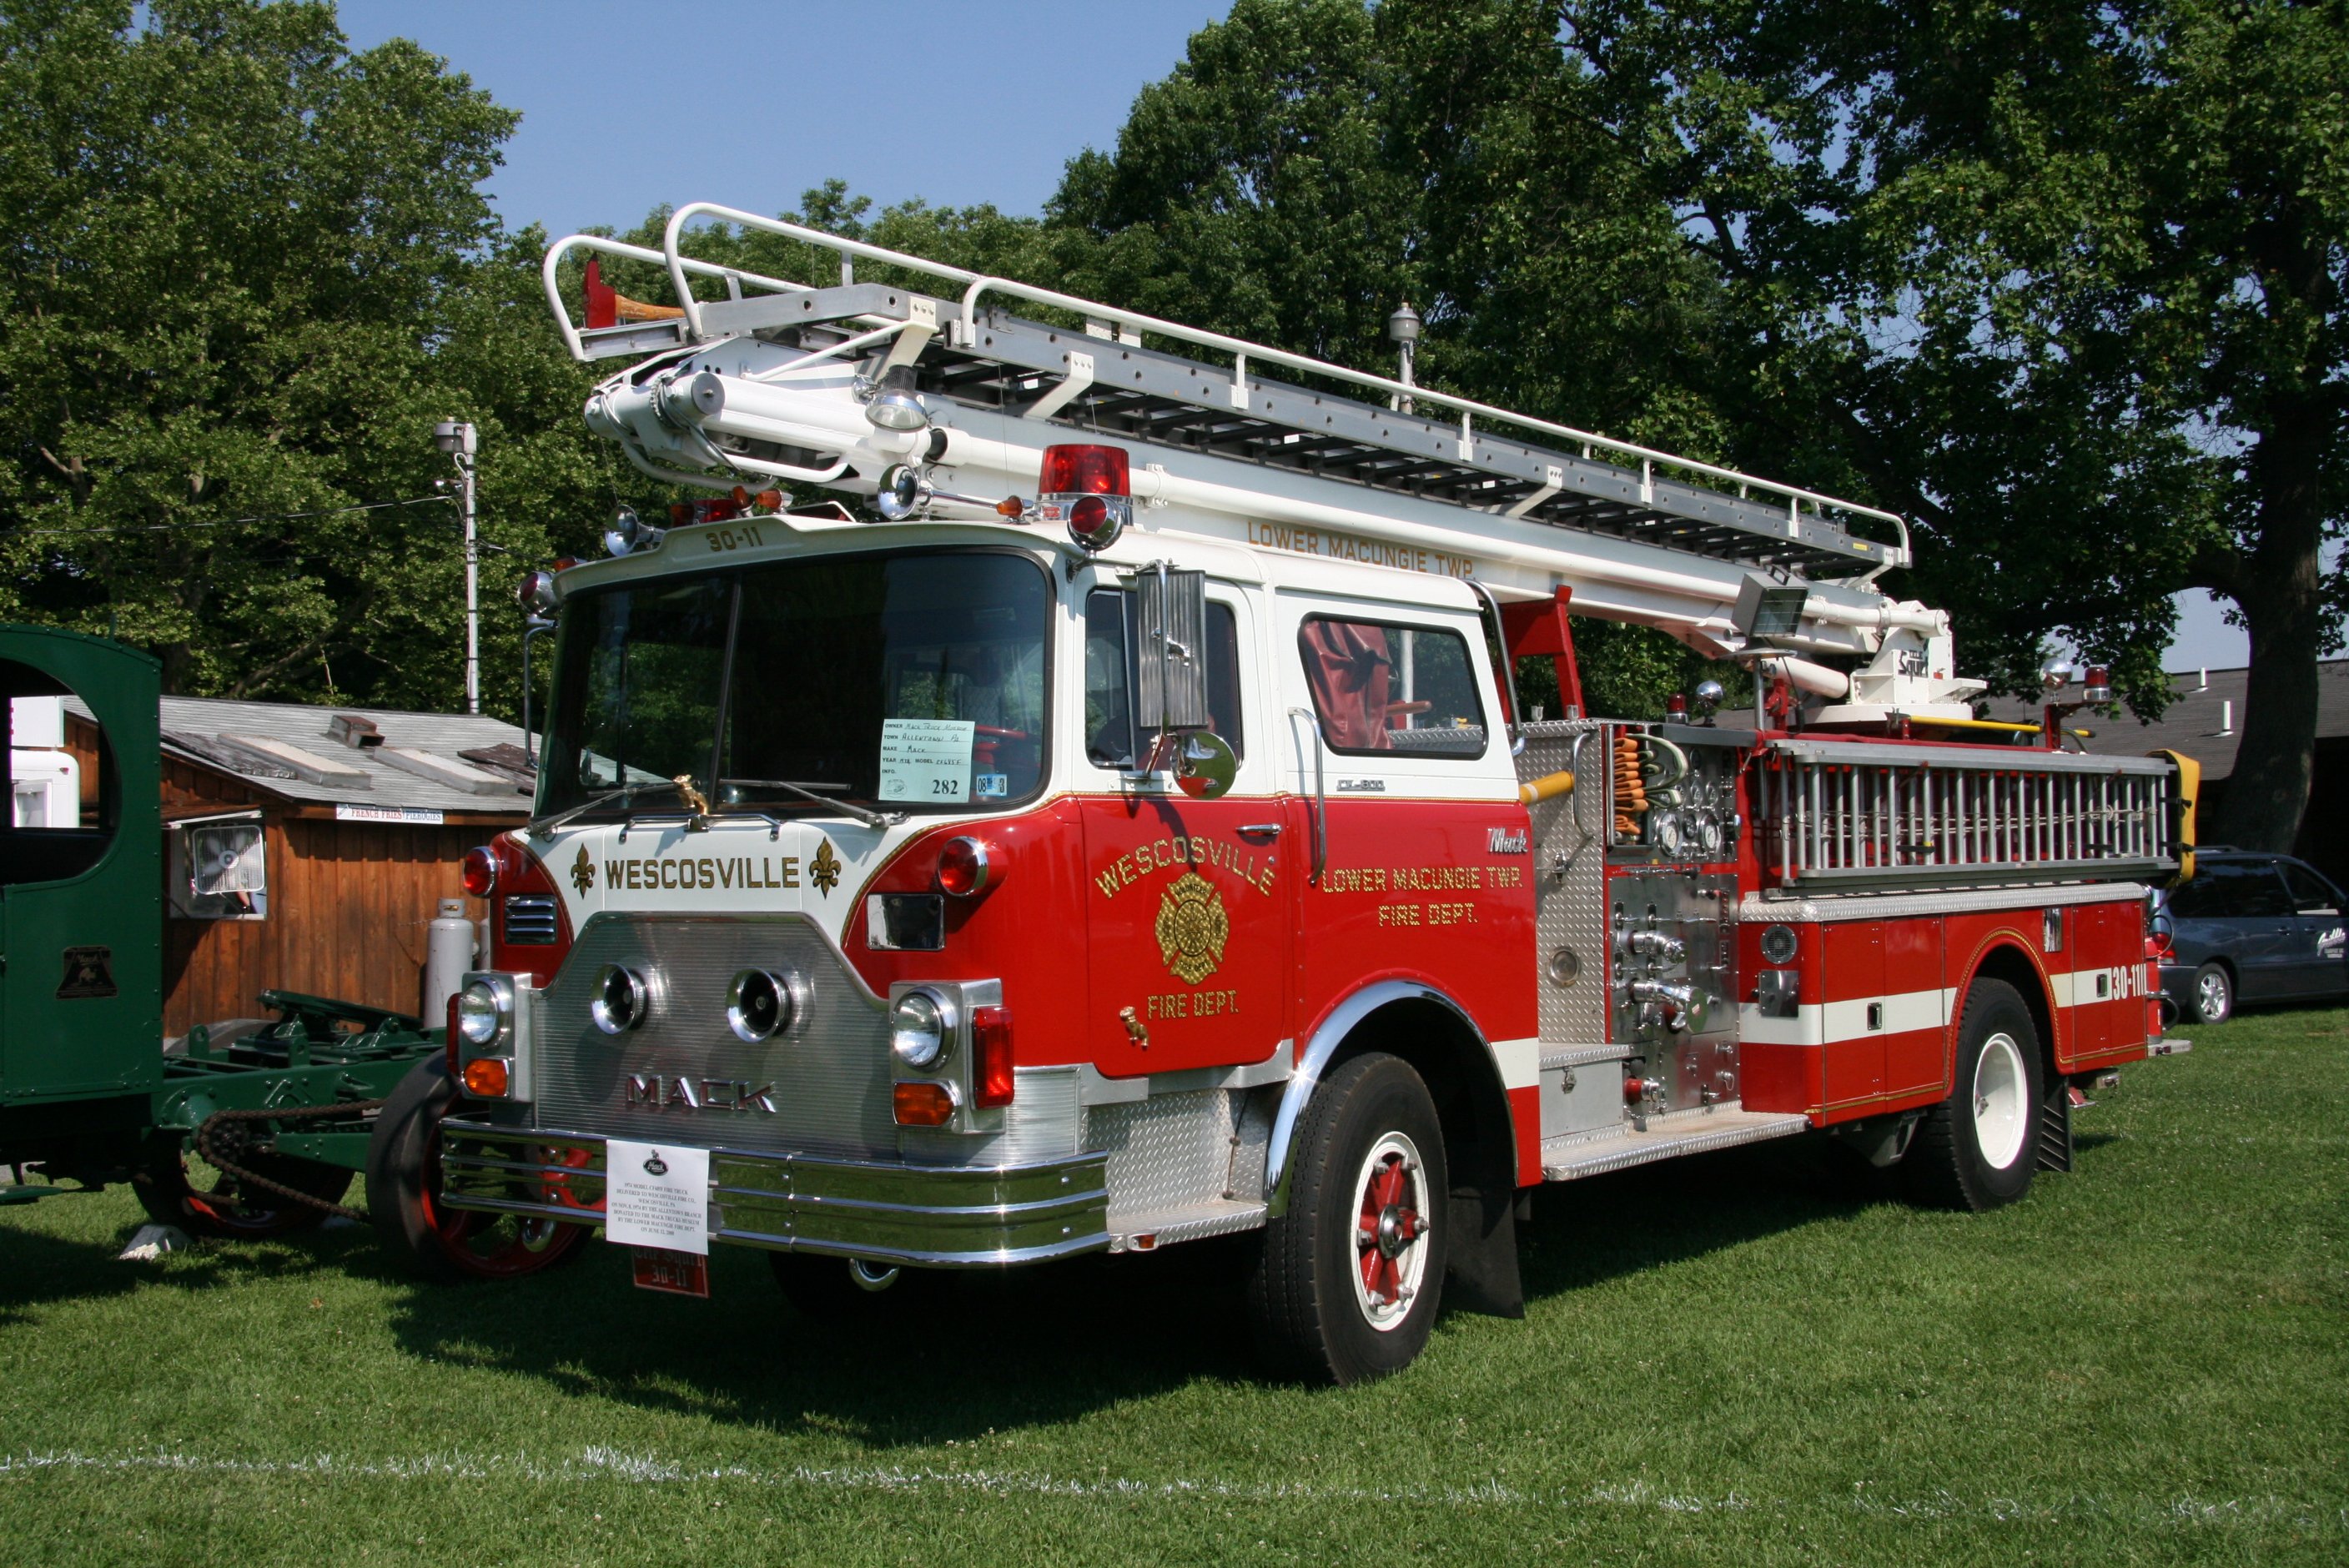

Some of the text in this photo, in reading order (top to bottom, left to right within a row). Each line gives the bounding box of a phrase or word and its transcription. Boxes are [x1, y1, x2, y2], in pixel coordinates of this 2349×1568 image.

[706, 526, 763, 552] 30-11
[1247, 520, 1476, 580] LOWER MACUNGIE TWP.
[933, 779, 958, 794] 282
[978, 777, 987, 792] 08
[351, 808, 379, 818] FRENCH
[405, 811, 440, 822] PIEROGIES
[1489, 827, 1528, 852] Mack
[605, 857, 800, 889] WESCOSVILLE
[1094, 836, 1275, 900] WESCOSVILLE
[1322, 867, 1523, 893] LOWER MACUNGIE TWP.
[1378, 902, 1478, 927] FIRE DEPT.
[1148, 990, 1240, 1020] FIRE DEPT.
[627, 1073, 777, 1113] MACK
